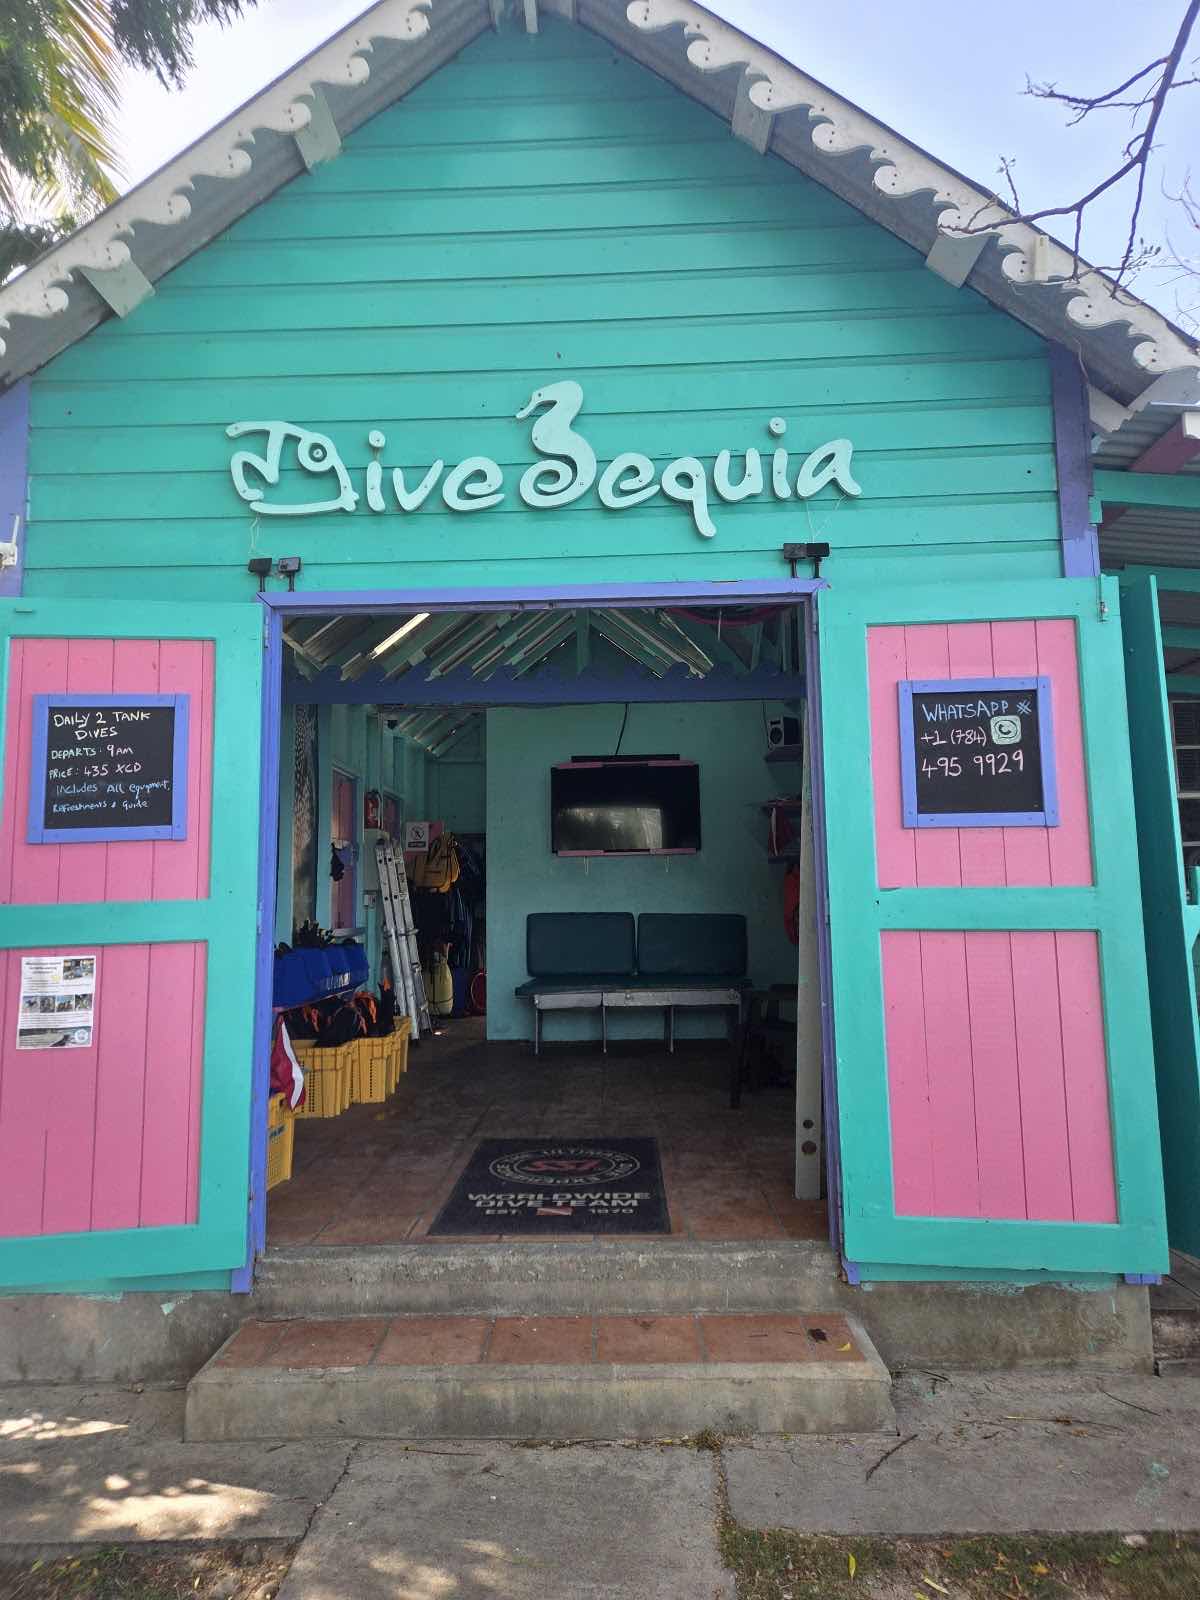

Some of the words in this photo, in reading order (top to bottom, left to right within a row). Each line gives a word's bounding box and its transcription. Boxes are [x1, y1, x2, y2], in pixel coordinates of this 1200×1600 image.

[53, 711, 90, 728] DAILY
[95, 711, 107, 724] 2
[112, 710, 151, 722] TANK
[74, 726, 118, 740] DIVES
[920, 730, 947, 746] +1
[950, 726, 987, 747] (784)
[83, 764, 109, 777] 435
[115, 761, 142, 774] XCD
[922, 756, 962, 779] 495
[973, 749, 1024, 777] 9929
[467, 1192, 650, 1201] WORLDWIDE
[475, 1200, 542, 1208] DIVE
